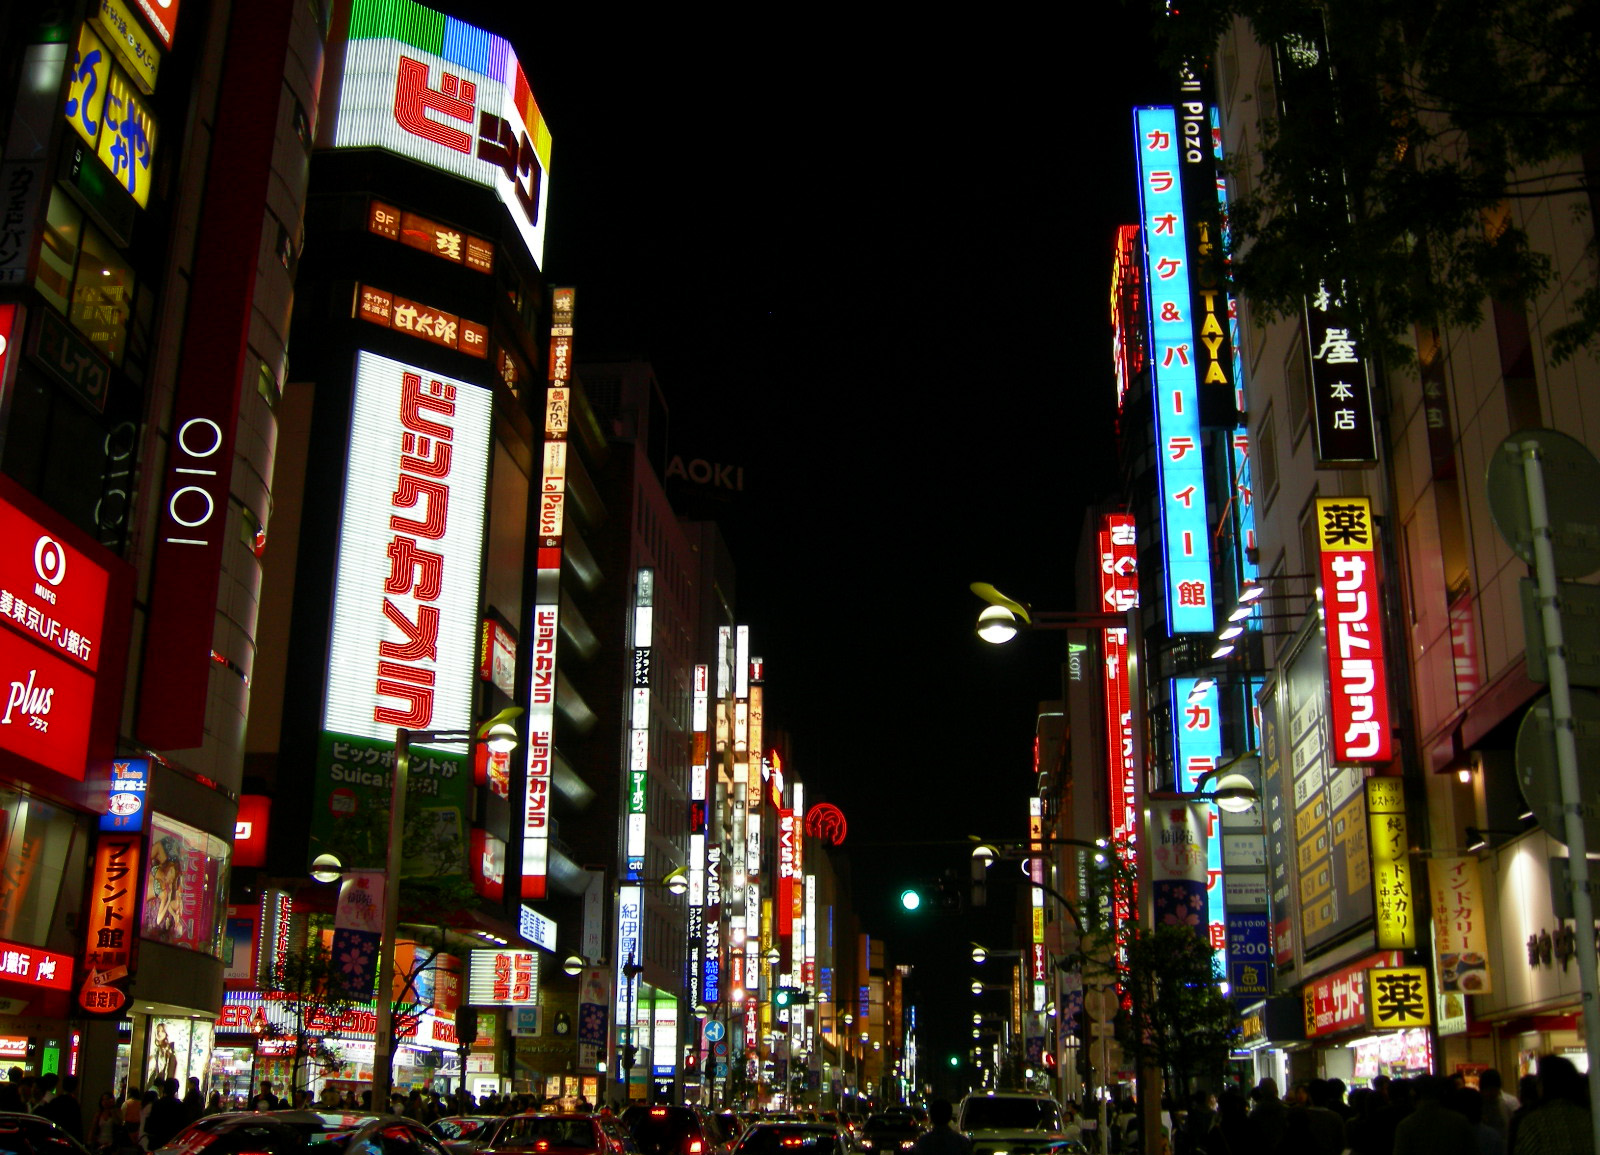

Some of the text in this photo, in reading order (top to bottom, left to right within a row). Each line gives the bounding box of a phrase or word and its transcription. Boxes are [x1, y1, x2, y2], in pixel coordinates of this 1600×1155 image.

[1182, 102, 1205, 164] Plaza
[375, 210, 395, 225] 9F
[394, 304, 458, 344] 甘太郎
[464, 329, 483, 344] 8F
[1331, 380, 1357, 430] 本店
[666, 454, 745, 492] AOKI
[1324, 504, 1368, 546] 薬
[373, 371, 457, 731] ビックカメラ
[35, 582, 57, 606] MUFG
[533, 610, 555, 705] ビックカメラ
[1331, 556, 1381, 758] サンドラッグ
[1, 668, 55, 725] plus
[332, 741, 458, 779] ビックポントが
[527, 731, 551, 828] ビックカメラ
[1371, 796, 1401, 806] レストラン
[781, 816, 794, 878] さくらや
[707, 847, 721, 906] さくらや
[1387, 817, 1409, 945] 純インド式カリー
[1380, 887, 1392, 921] 中村屋
[1450, 862, 1473, 949] インドカリー
[619, 903, 638, 1002] 紀伊國店
[1231, 943, 1267, 954] 2:00
[214, 1005, 269, 1027] ERA
[305, 1005, 419, 1037] ビックカラ
[1374, 974, 1425, 1022] 薬
